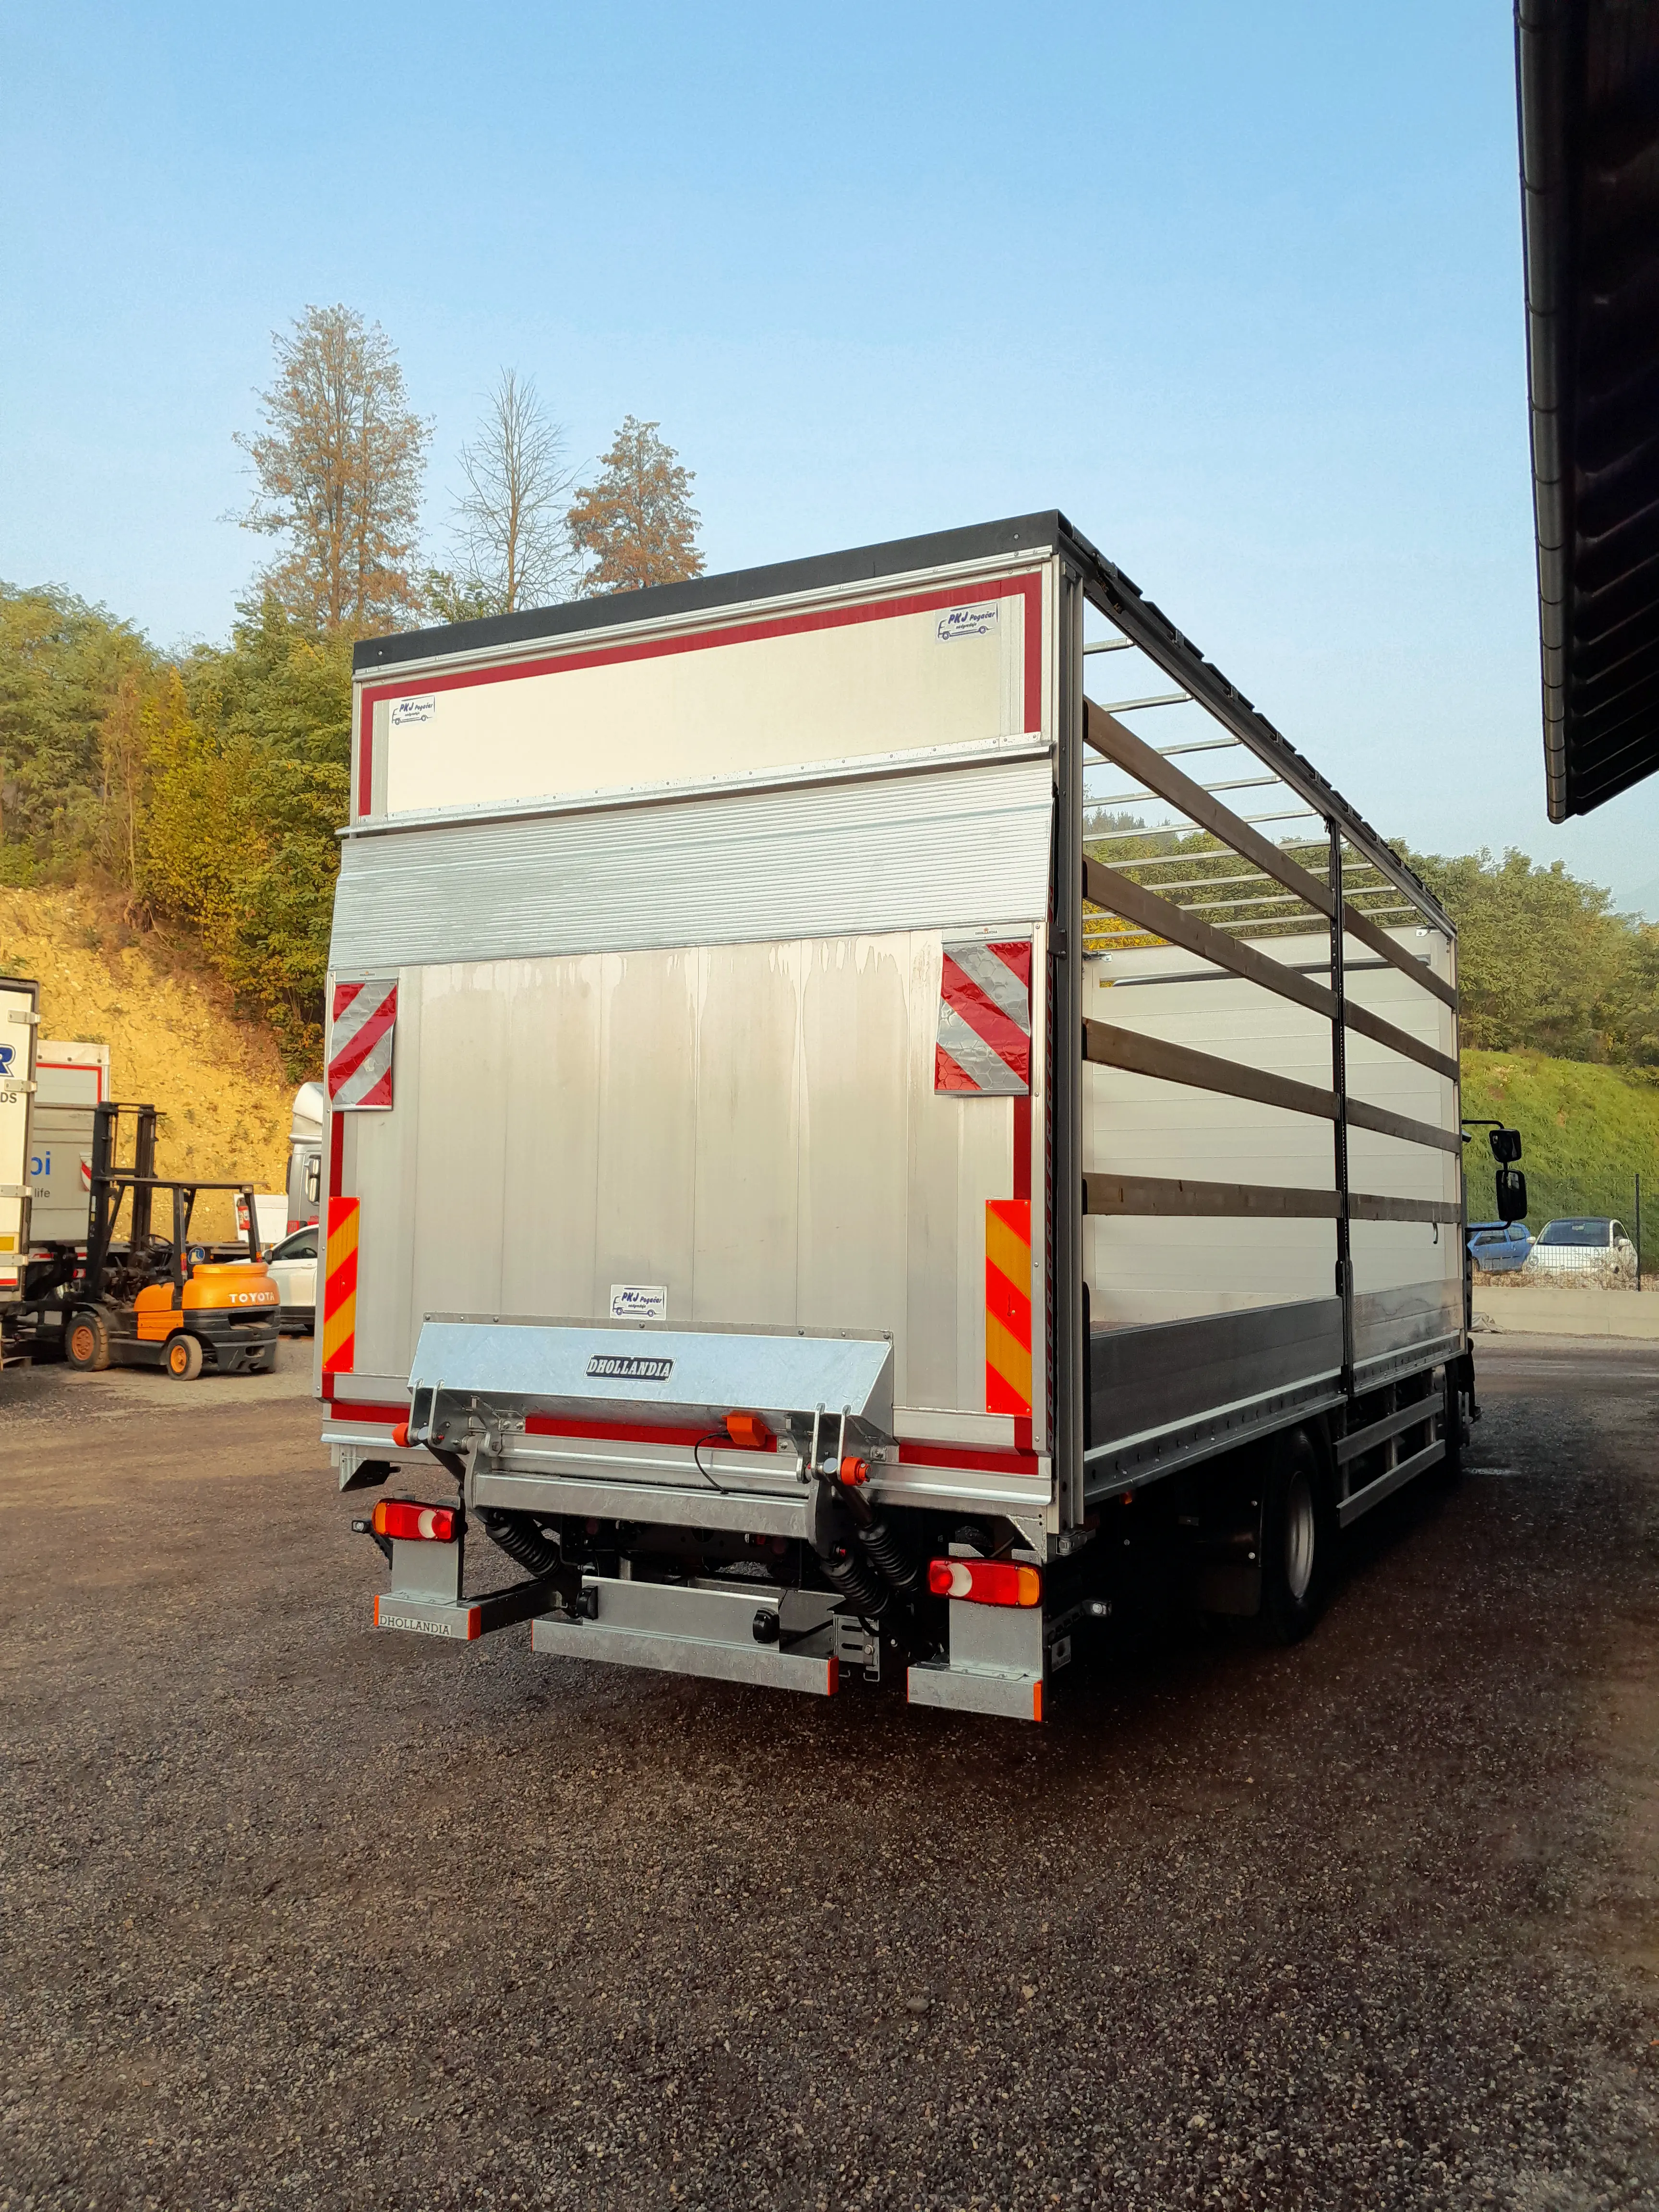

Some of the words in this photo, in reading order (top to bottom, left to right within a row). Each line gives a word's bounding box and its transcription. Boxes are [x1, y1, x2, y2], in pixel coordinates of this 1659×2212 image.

[948, 611, 969, 625] PKJ
[969, 611, 996, 622] Pogačar
[399, 702, 414, 712] PKJ
[35, 1188, 50, 1198] life
[228, 1291, 275, 1303] TOYOTA
[621, 1292, 639, 1302] PKJ
[640, 1296, 662, 1304] Pogačar
[587, 1359, 671, 1377] DHOLLANDIA
[379, 1615, 450, 1635] DHOLLANDIA
